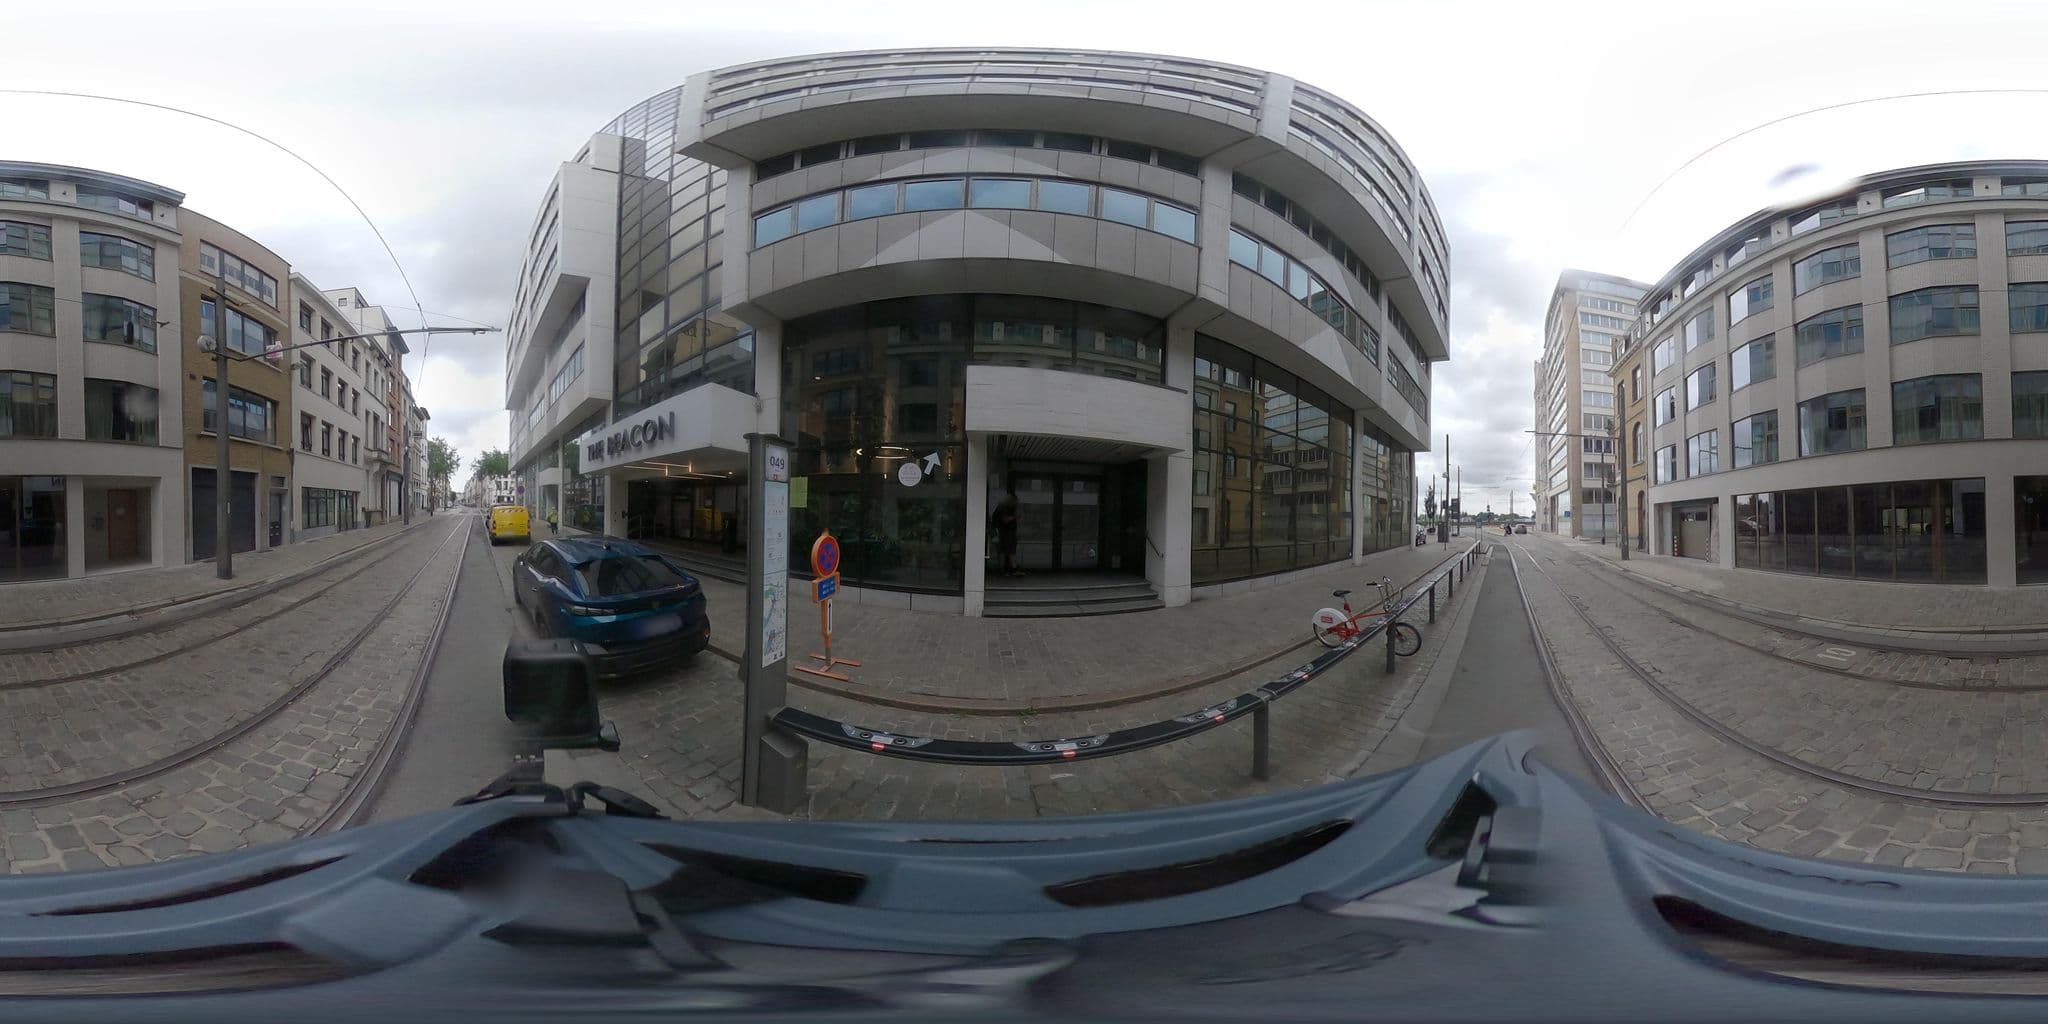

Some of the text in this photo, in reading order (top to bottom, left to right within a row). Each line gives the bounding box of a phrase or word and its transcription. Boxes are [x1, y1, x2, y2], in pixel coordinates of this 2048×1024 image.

[587, 411, 675, 462] THE BEACON
[769, 456, 785, 470] 049
